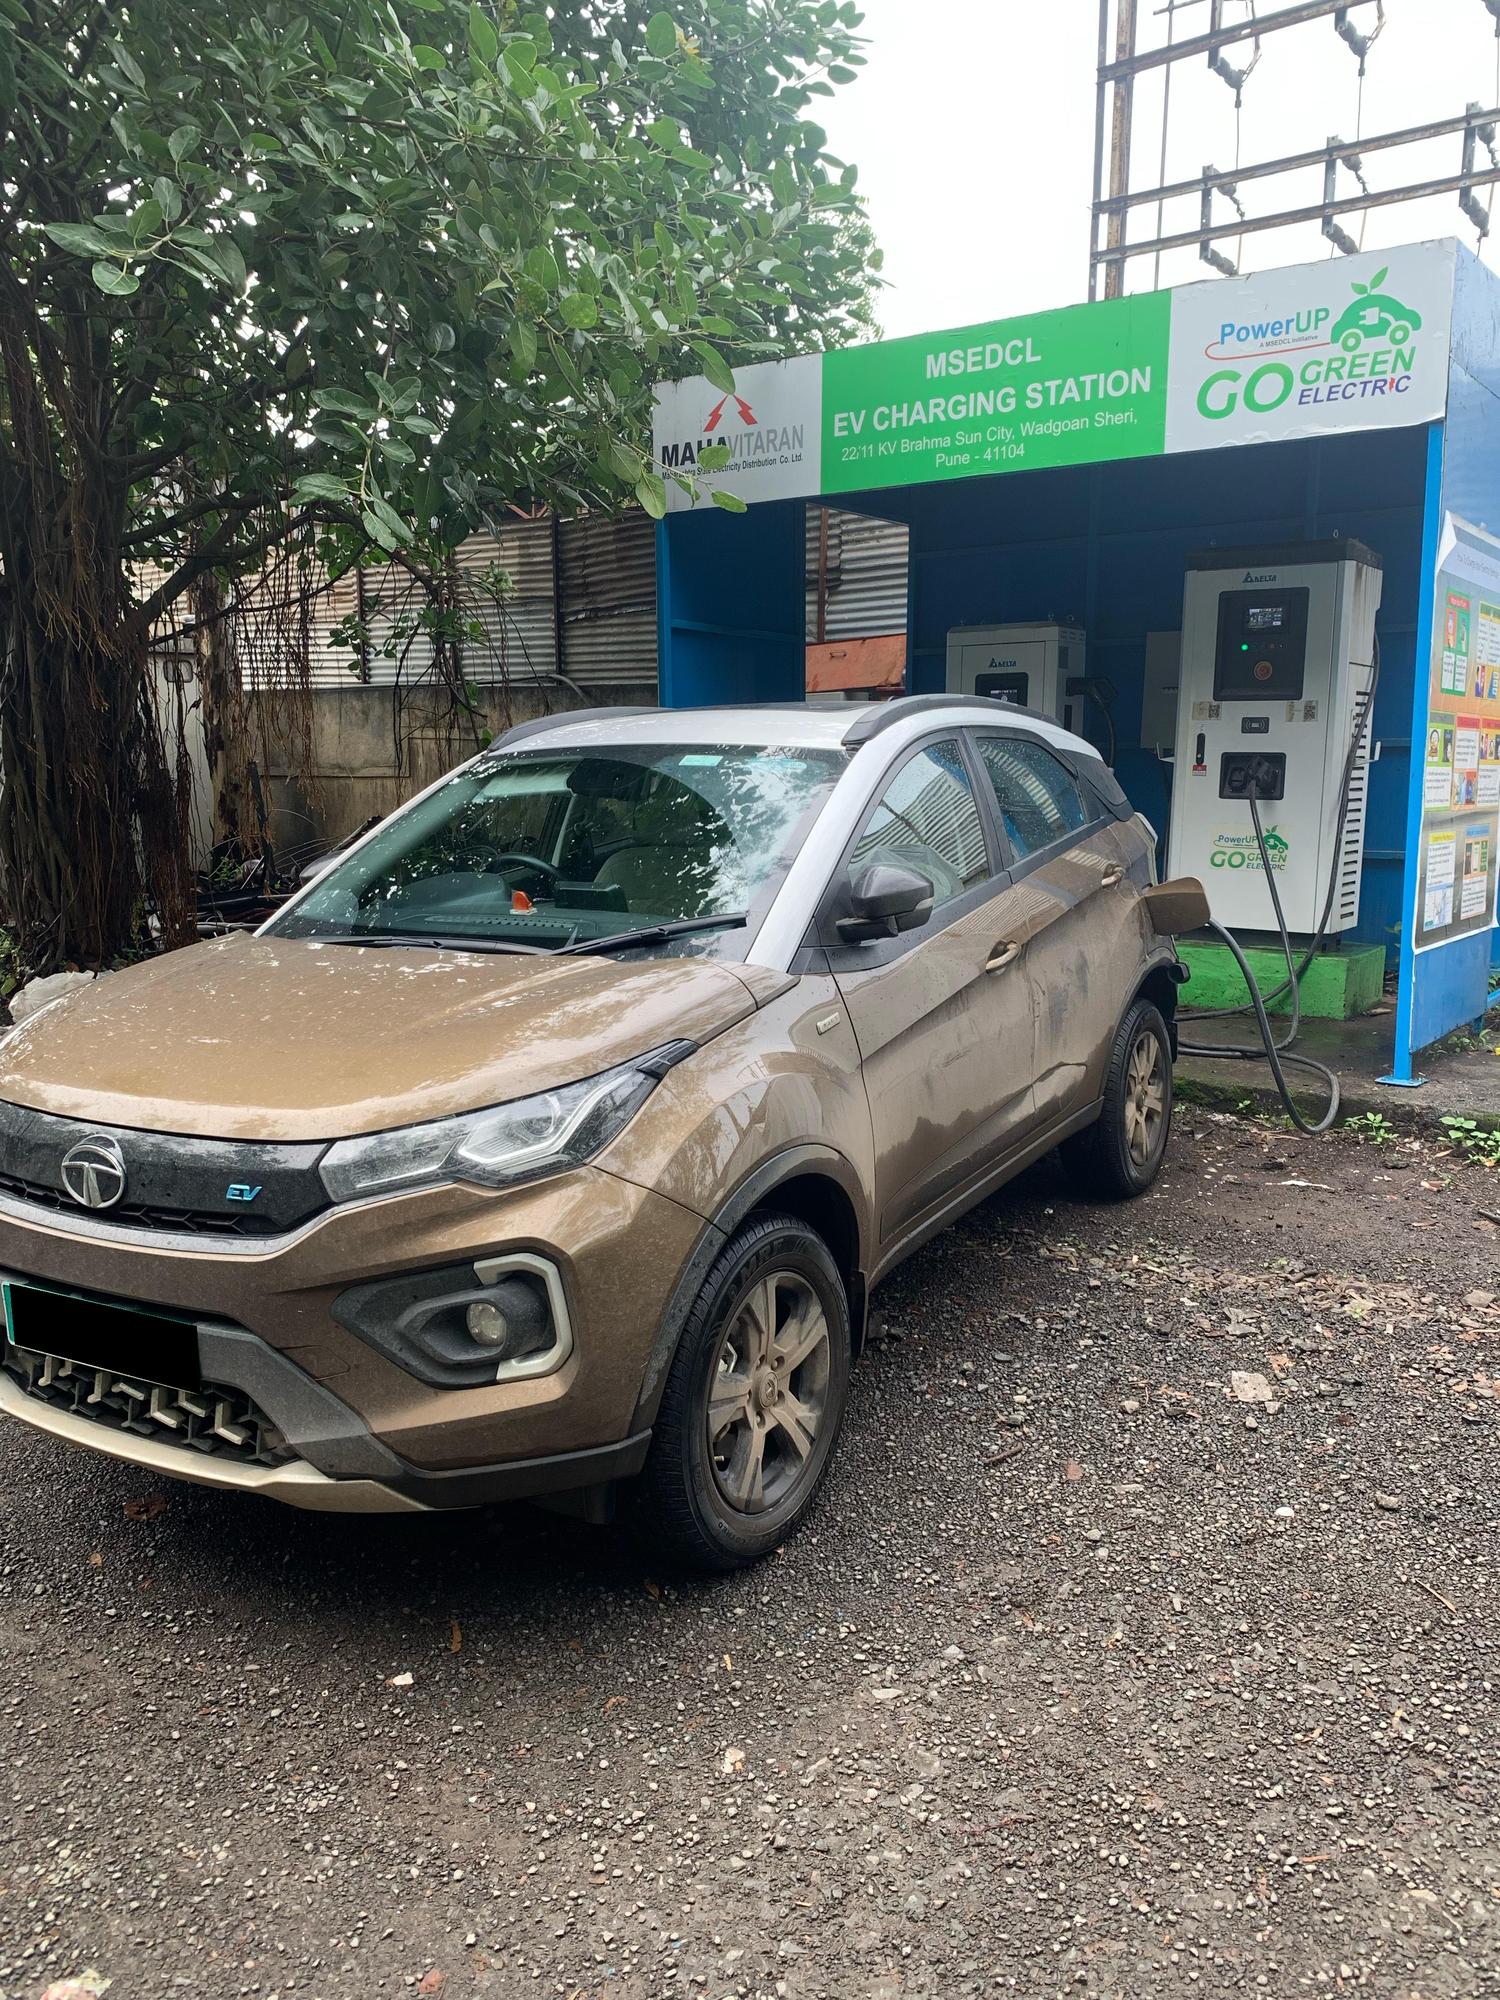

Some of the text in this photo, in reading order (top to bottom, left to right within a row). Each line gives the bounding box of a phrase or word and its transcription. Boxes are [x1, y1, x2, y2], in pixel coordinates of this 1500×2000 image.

[1220, 307, 1330, 345] PowerUP
[926, 338, 1041, 379] MSEDCL
[1196, 346, 1416, 420] GO GREEN
[834, 366, 1151, 437] EV CHARGING STATION
[878, 440, 897, 457] KV
[901, 435, 951, 453] Brahma
[955, 431, 982, 446] Sun
[986, 426, 1015, 443] City,
[1020, 418, 1089, 437] Wadgoan
[1094, 408, 1138, 428] Sheri,
[743, 458, 777, 470] Distribution
[780, 455, 789, 464] Co.
[936, 452, 970, 468] Pune
[983, 443, 1025, 462] 41104
[1218, 834, 1259, 844] PowerUP
[1210, 850, 1287, 869] GO GREN
[226, 1184, 262, 1200] EV
